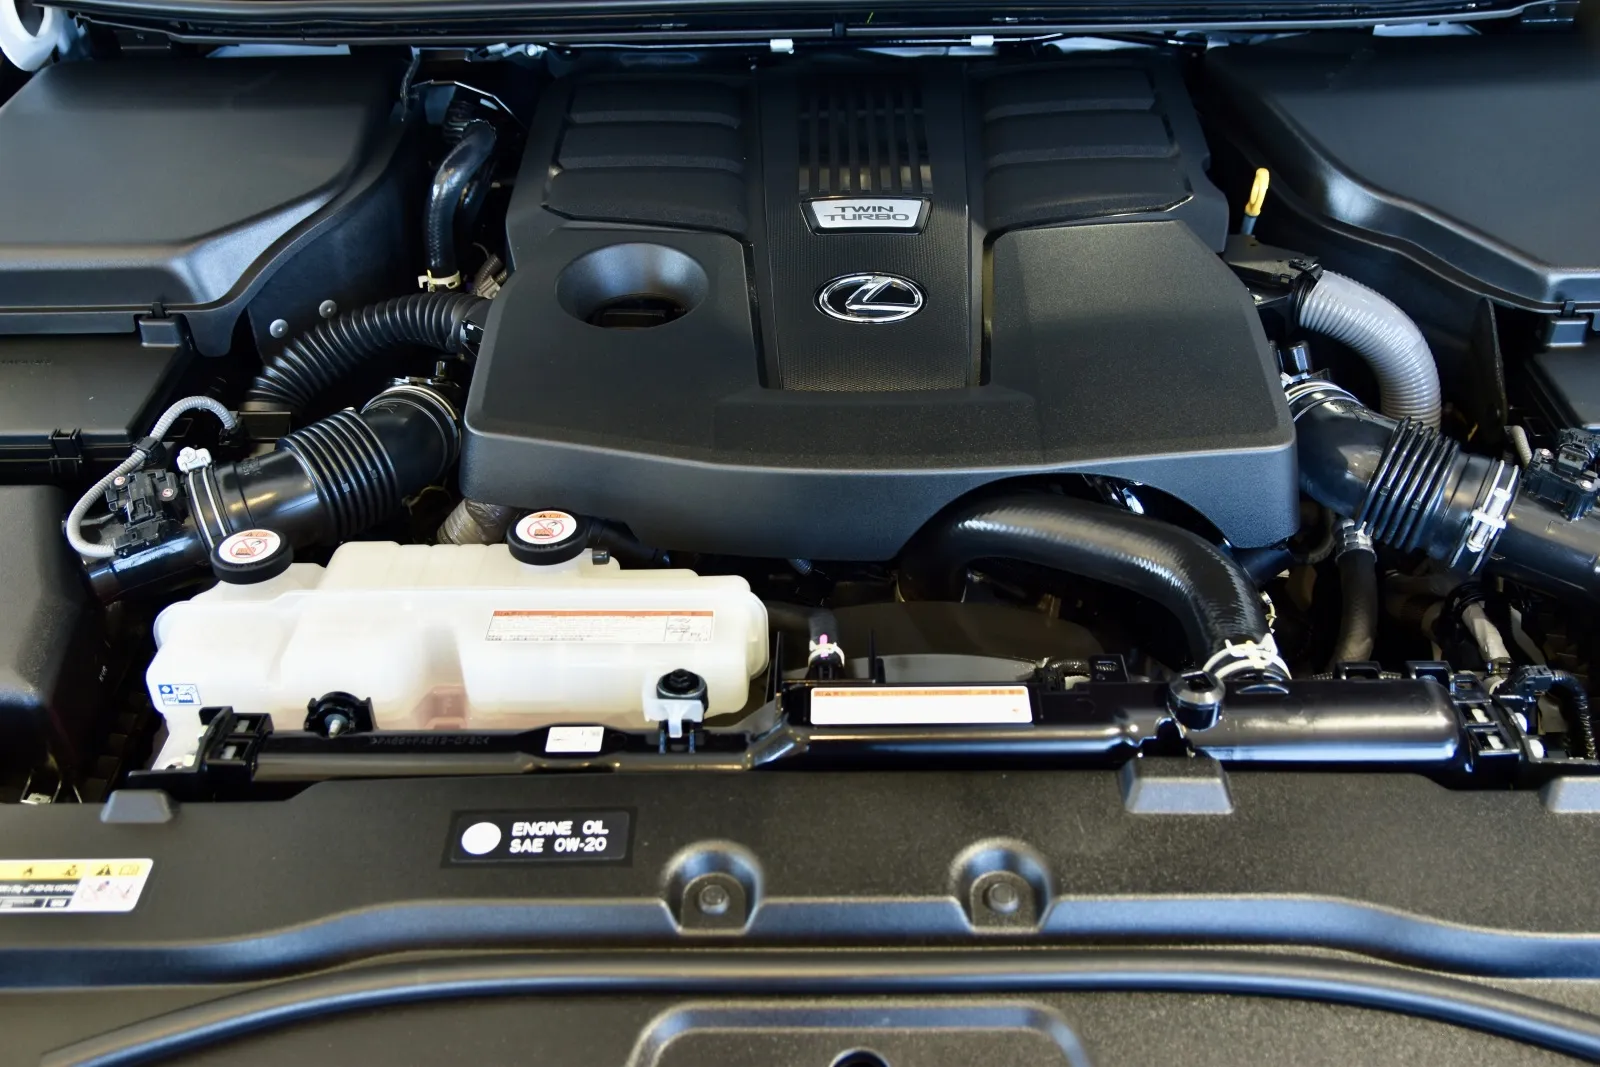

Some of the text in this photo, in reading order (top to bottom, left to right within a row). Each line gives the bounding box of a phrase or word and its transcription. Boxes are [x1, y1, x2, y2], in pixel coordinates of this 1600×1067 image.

[834, 205, 894, 213] TWIN
[823, 213, 910, 222] TURBO
[511, 820, 609, 836] ENGINE OIL
[509, 836, 607, 853] SAE 0W-20
